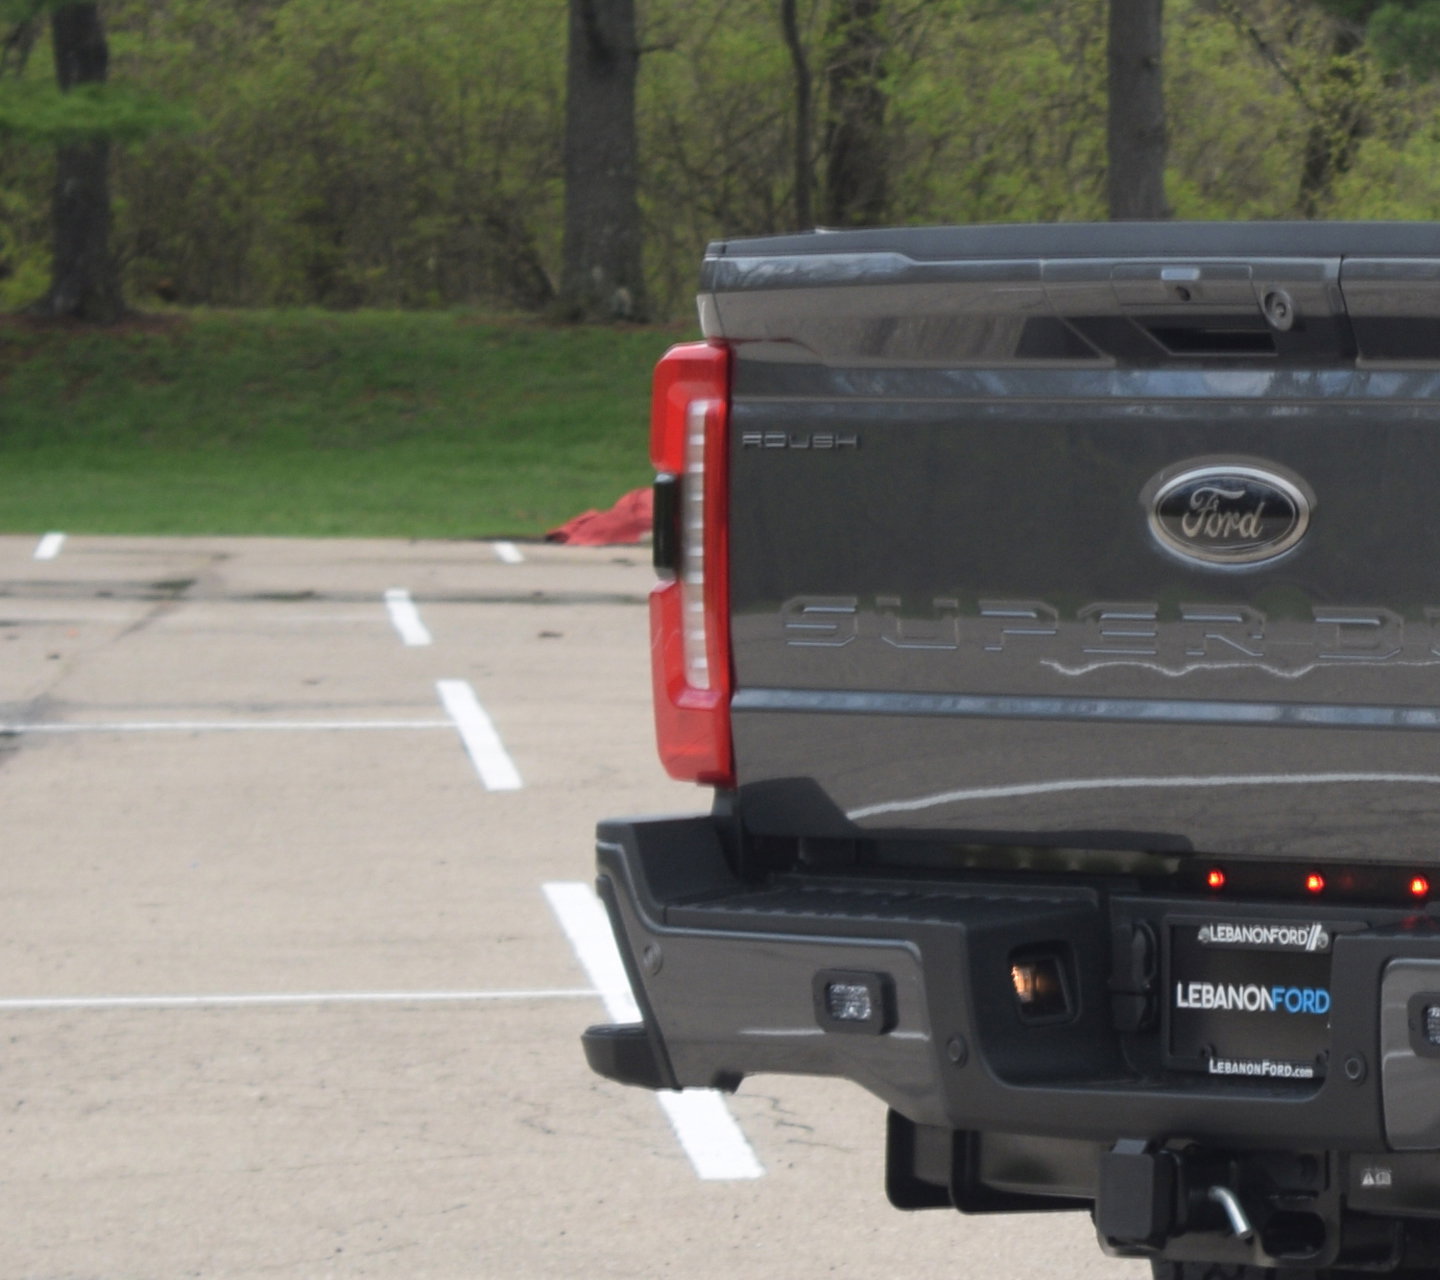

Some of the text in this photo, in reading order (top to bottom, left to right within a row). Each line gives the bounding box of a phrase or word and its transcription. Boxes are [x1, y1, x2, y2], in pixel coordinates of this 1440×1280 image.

[742, 430, 857, 449] ROUSH
[1182, 487, 1265, 538] Ford
[781, 595, 1265, 658] SUPER
